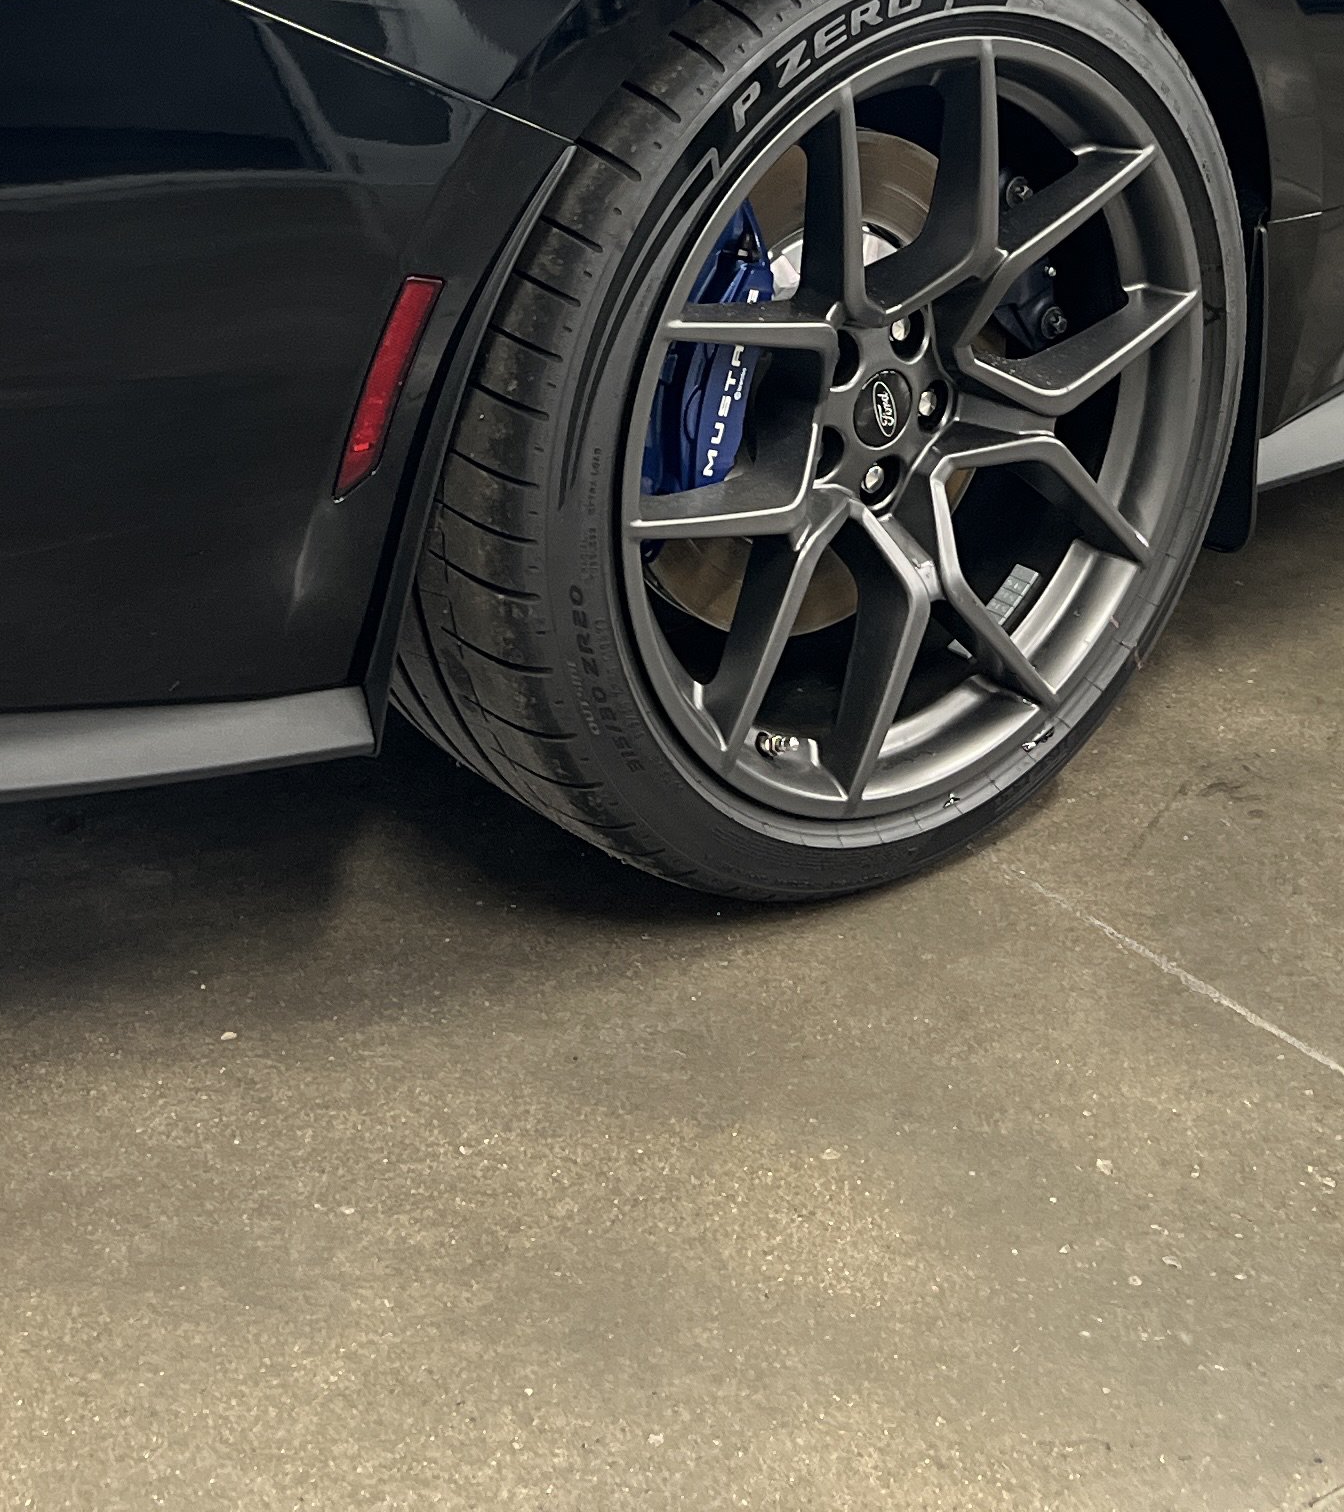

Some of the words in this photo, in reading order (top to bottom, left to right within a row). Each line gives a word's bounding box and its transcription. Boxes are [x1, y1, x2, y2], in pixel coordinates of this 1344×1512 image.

[732, 81, 761, 133] P
[876, 390, 895, 427] Ford
[568, 583, 601, 678] ZR20
